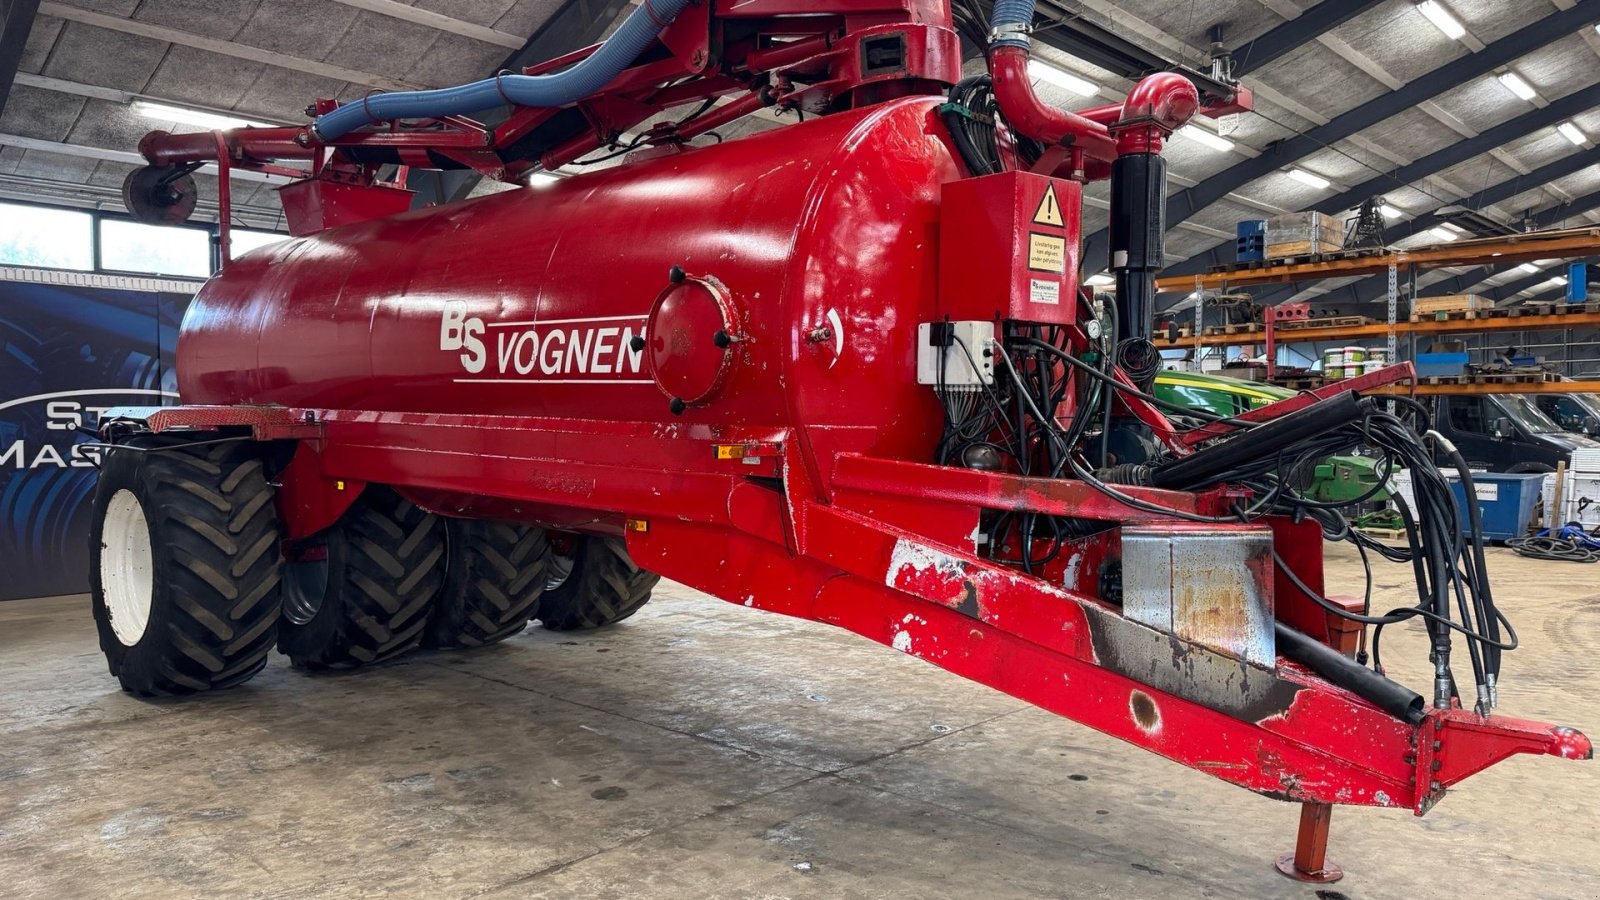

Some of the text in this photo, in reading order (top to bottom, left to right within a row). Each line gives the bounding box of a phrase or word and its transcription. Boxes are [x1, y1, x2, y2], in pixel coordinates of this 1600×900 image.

[440, 300, 647, 375] BS VOGNEN
[46, 401, 113, 430] ST
[0, 439, 111, 469] MAS
